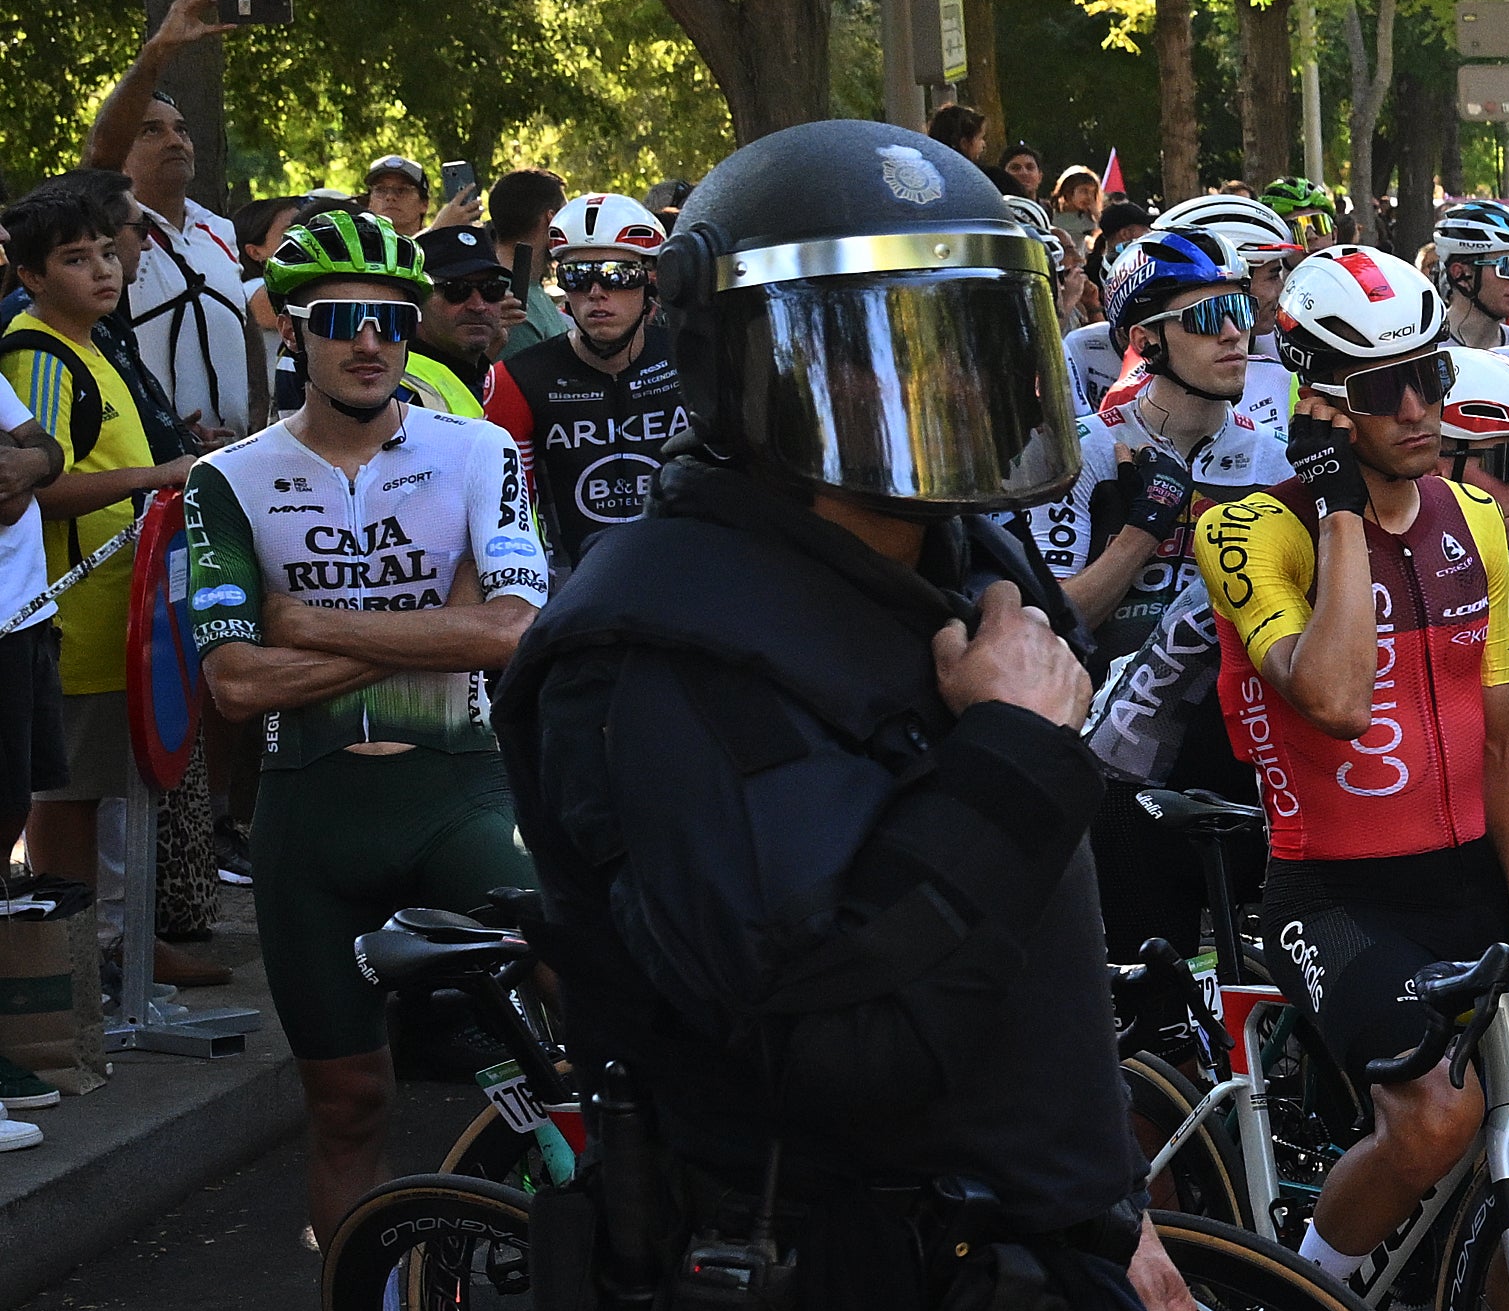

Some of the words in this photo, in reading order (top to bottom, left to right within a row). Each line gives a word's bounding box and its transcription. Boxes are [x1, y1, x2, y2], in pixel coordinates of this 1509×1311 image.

[1458, 241, 1494, 251] RUDY
[549, 391, 604, 400] Bianchi
[546, 405, 690, 450] ARKEA
[382, 470, 434, 492] GSPORT
[498, 447, 518, 530] RGA
[589, 479, 610, 500] B
[615, 476, 632, 495] &
[187, 487, 222, 571] ALEA
[304, 515, 412, 556] CAJA
[488, 540, 535, 557] KMC
[283, 548, 437, 593] RURAL
[194, 586, 244, 605] KMC
[1280, 921, 1324, 1014] Cofidis
